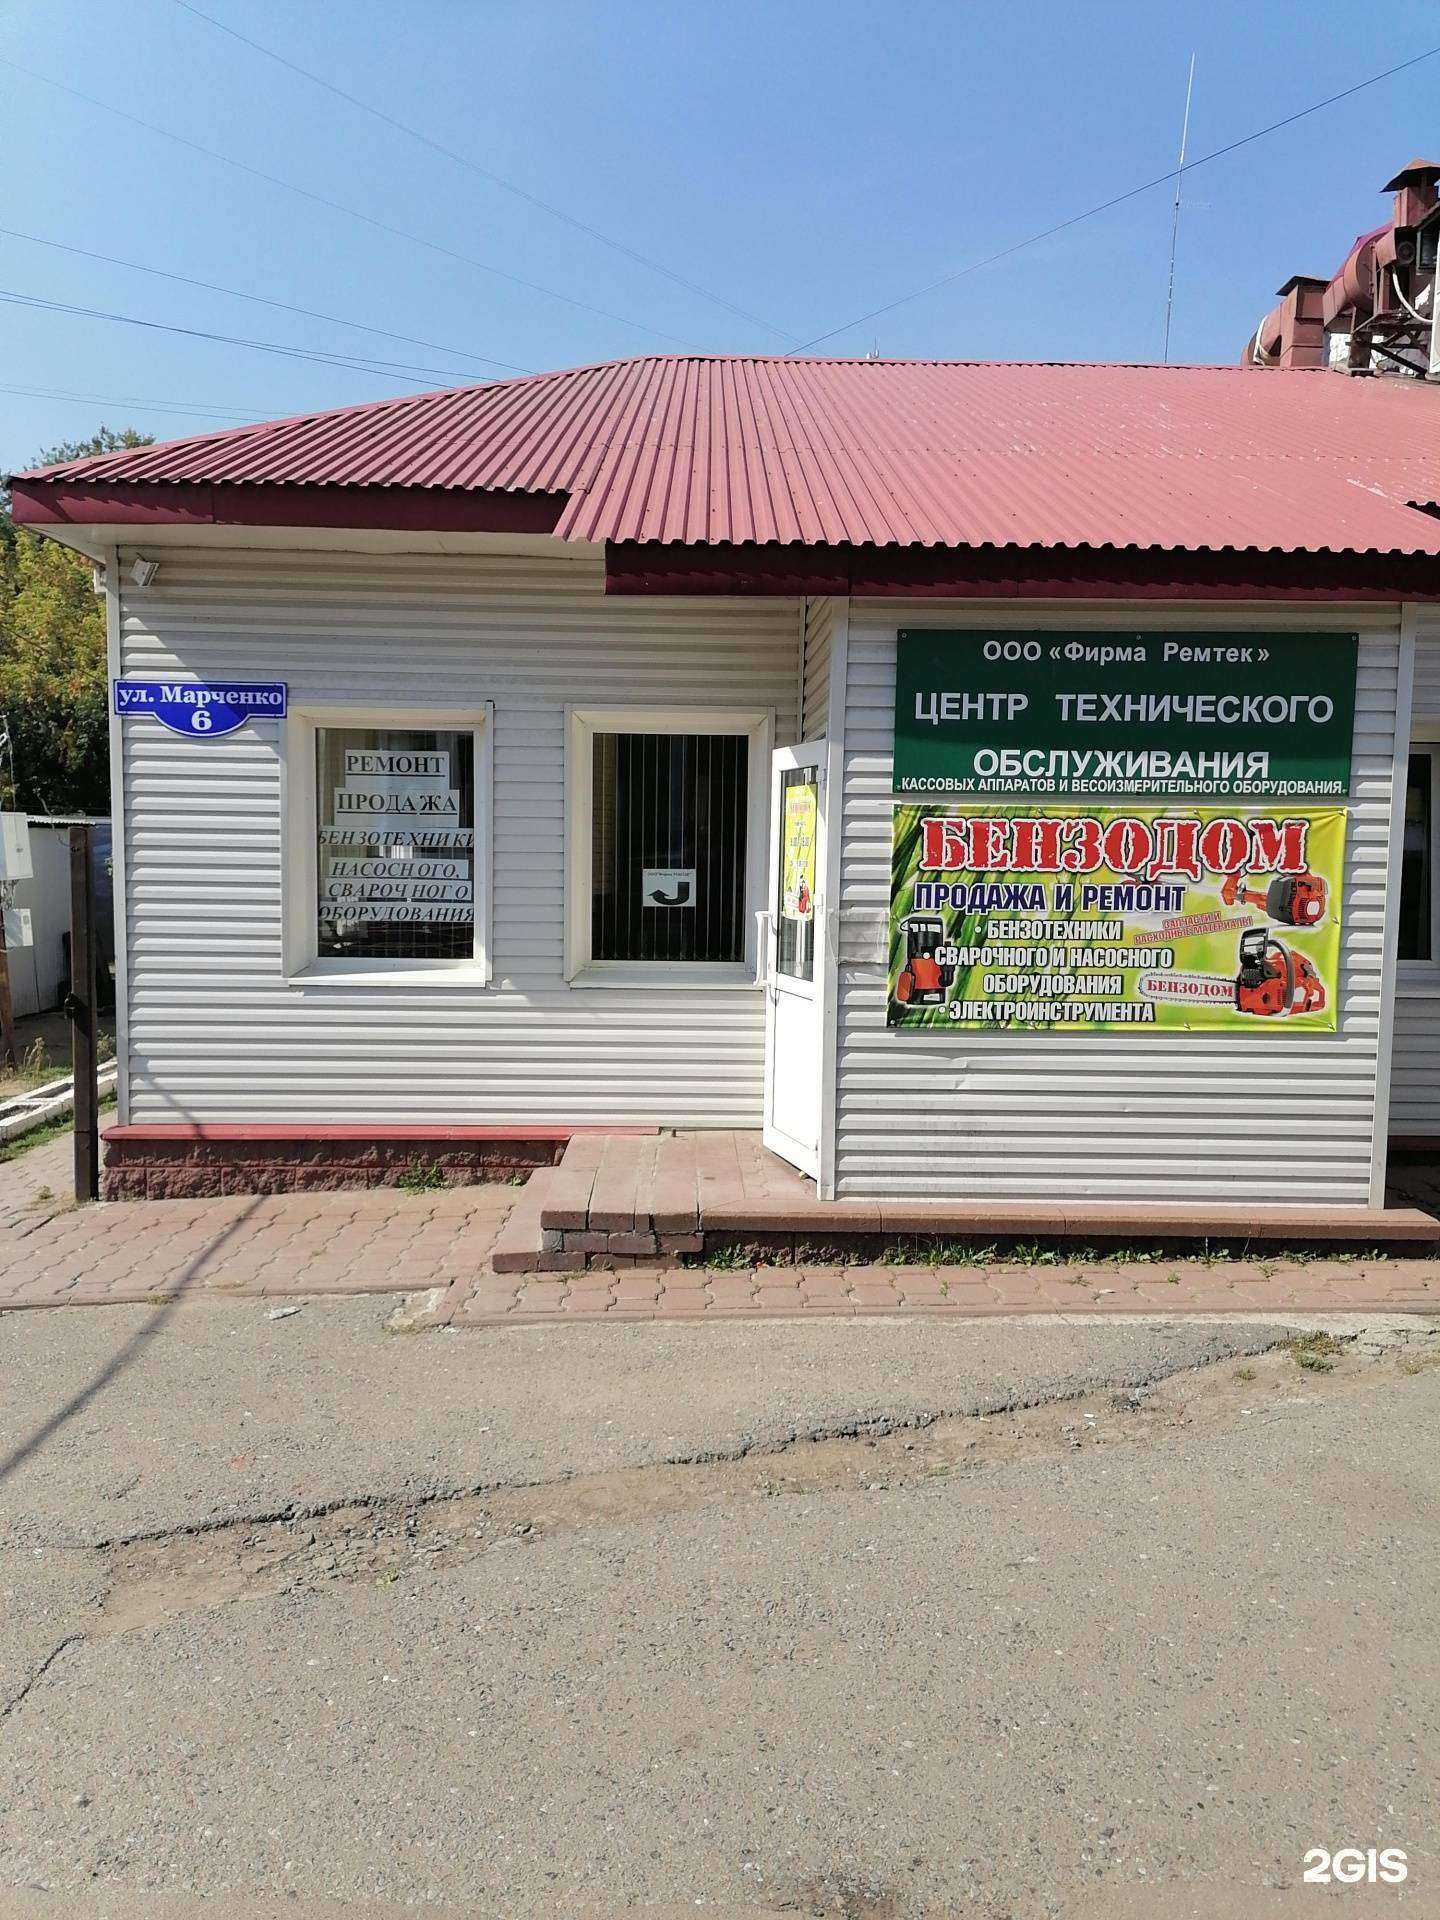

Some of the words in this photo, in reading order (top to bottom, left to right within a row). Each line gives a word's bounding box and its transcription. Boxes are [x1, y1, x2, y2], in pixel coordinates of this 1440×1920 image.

[983, 640, 1042, 661] ООО
[1049, 641, 1146, 666] «Фирма
[1163, 642, 1270, 663] Ремтек»
[119, 688, 154, 706] ул.
[160, 685, 282, 708] Марченко
[915, 692, 1029, 725] ЦЕНТР
[1055, 693, 1334, 724] ТЕХНИЧЕСКОГО
[191, 710, 213, 731] 6
[346, 755, 445, 774] РЕМОНТ
[973, 749, 1270, 779] ОБСЛУЖИВАНИЯ
[901, 777, 975, 791] КАССОВЫХ
[977, 778, 1056, 792] АППАРАТОВ
[1059, 779, 1069, 792] И
[1071, 779, 1230, 794] ВЕСОИЗМЕРИТЕЛЬНОГО
[1232, 780, 1343, 796] ОБОРУДОВАНИЯ
[337, 793, 457, 814] ПРОДАЖА
[920, 817, 1310, 882] БЕНЗОДОМ
[328, 883, 469, 899] СВАРОЧНОГО
[914, 882, 1047, 915] ПРОДАЖА
[1054, 884, 1073, 911] И
[1082, 884, 1187, 913] РЕМОНТ
[318, 906, 475, 921] ОБОРУДОВАНИЯ
[987, 920, 1122, 940] БЕНЗОТЕХНИКИ
[934, 946, 1051, 967] СВАРОЧНОГО
[1052, 948, 1067, 967] И
[1069, 948, 1174, 968] НАСОСНОГО
[983, 974, 1122, 996] ОБОРУДОВАНИЯ
[1146, 979, 1234, 997] БЕНЗОДОМ
[949, 1001, 1154, 1021] ЭЛЕКТРОИНСТРУМЕНТА
